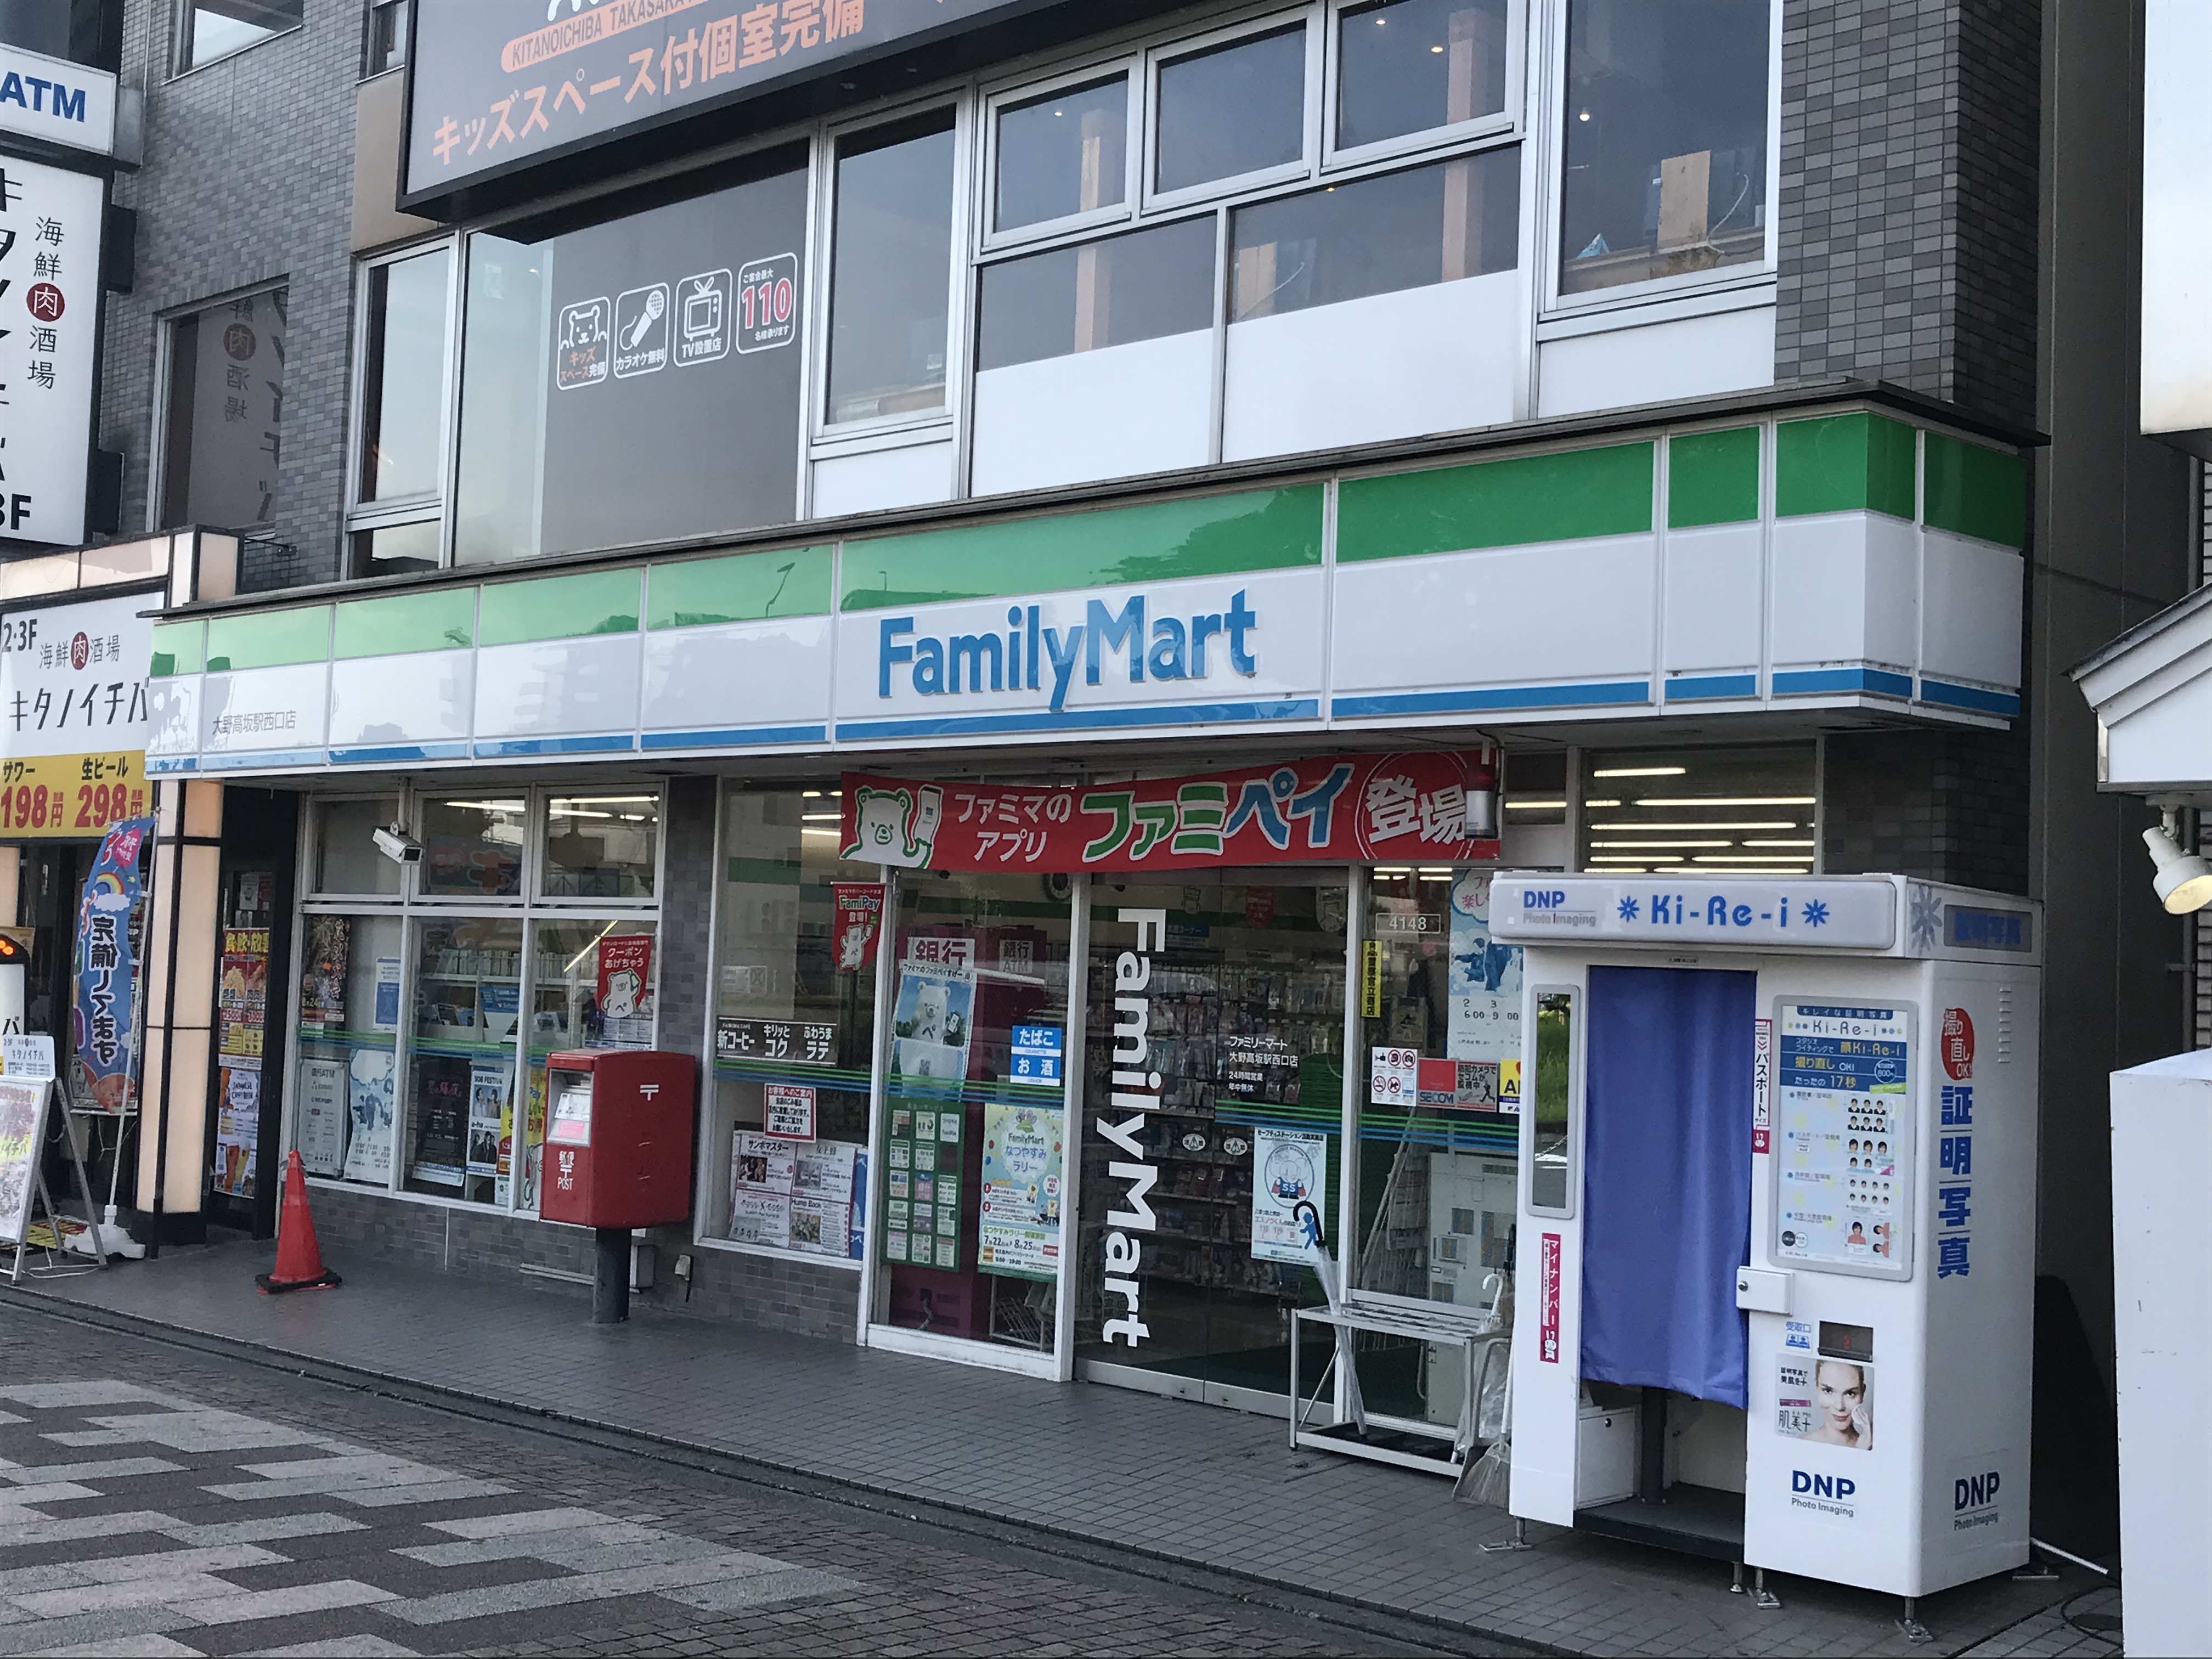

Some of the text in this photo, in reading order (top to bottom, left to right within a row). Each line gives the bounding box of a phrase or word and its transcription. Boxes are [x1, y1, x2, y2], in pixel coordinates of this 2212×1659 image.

[512, 13, 602, 67] KITANOICHIBA
[0, 72, 86, 122] ATM
[27, 216, 64, 390] 海鮮肉酒場
[742, 278, 792, 329] 110
[569, 346, 596, 366] キッズ
[681, 337, 721, 359] TV設置店
[616, 348, 665, 371] カラオケ無料
[39, 635, 120, 670] 海鮮肉酒場
[879, 588, 1257, 713] FamilyMart
[212, 709, 296, 735] 大野高坂駅西口店
[3, 755, 128, 783] サワー 生ビール
[955, 793, 1071, 824] ファミマの
[1081, 763, 1355, 863] ファミペイ
[1365, 774, 1465, 844] 登場
[974, 828, 1047, 862] アプリ
[839, 895, 880, 912] FamiPay
[1523, 890, 1565, 908] DNP
[1523, 913, 1596, 927] Photo Imaging
[1651, 895, 1787, 928] Ki-Re-i
[1389, 916, 1426, 930] 4148
[608, 946, 642, 957] クーポン
[915, 940, 967, 969] 銀行
[1003, 941, 1029, 959] 銀行
[605, 957, 644, 968] あげちゃう
[1003, 960, 1029, 973] ATM
[1802, 1008, 1887, 1019] キレイな証明写真
[1943, 1009, 1963, 1036] 撮り
[764, 1024, 790, 1038] キリッと
[804, 1026, 832, 1040] ふわうま
[1813, 1020, 1877, 1036] Ki-Re-i
[717, 1029, 755, 1050] 新コーヒー
[1019, 1029, 1053, 1046] たばこ
[1229, 1036, 1288, 1051] ファミリーマート
[765, 1038, 788, 1058] コク
[806, 1041, 829, 1060] ラテ
[1950, 1037, 1970, 1063] 直し
[1229, 1051, 1298, 1068] 大野高坂駅西口店
[1795, 1056, 1855, 1071] 撮り直し OK!
[1228, 1071, 1263, 1081] 24時間営業
[1458, 1065, 1496, 1075] 防犯カメラで
[1228, 1082, 1254, 1092] 年中無休
[1458, 1080, 1480, 1090] 監視中
[1756, 1053, 1769, 1117] パスポート
[1795, 1076, 1826, 1086] たったの
[1420, 1092, 1454, 1104] SECOM
[1097, 908, 1166, 1348] FamilyMart
[748, 1139, 789, 1152] サンボマスター
[1008, 1132, 1044, 1146] FamilyMart
[559, 1150, 574, 1166] 郵便
[1006, 1146, 1047, 1159] なつやすみ
[1013, 1160, 1037, 1172] ラリー
[557, 1177, 574, 1190] POST
[1282, 1183, 1296, 1193] SS
[1938, 1086, 1973, 1279] 証明写真
[1549, 1240, 1559, 1325] マイナンバー
[1786, 1321, 1811, 1333] 受取口
[1792, 1470, 1855, 1500] DNP
[1955, 1471, 2001, 1511] DNP
[1792, 1498, 1854, 1517] Photo Imaging
